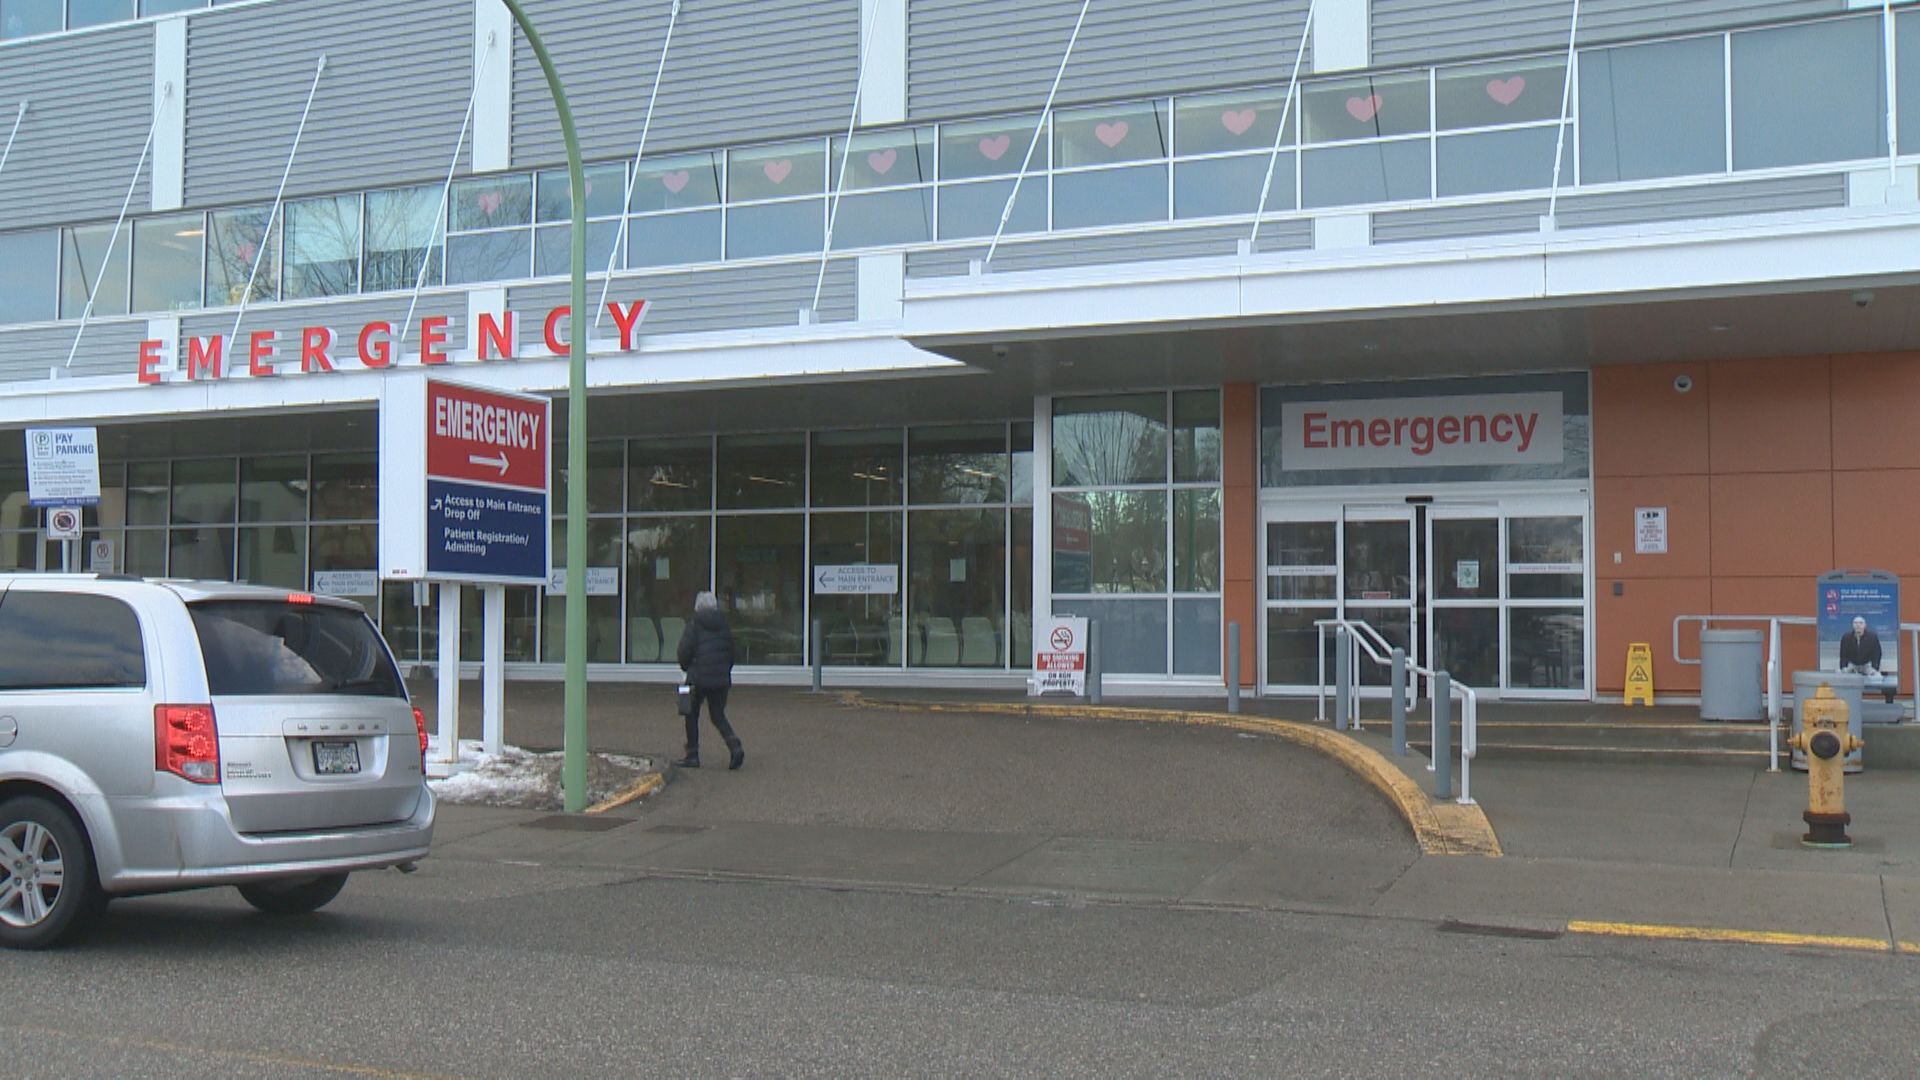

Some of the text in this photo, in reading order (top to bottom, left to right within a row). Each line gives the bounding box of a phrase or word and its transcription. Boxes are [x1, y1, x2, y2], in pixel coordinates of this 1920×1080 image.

[138, 300, 649, 384] EMERGENCY
[436, 396, 540, 451] EMERGENCY
[55, 433, 73, 444] PAY
[1303, 412, 1539, 456] Emergency
[56, 443, 95, 455] PARKING
[445, 493, 541, 514] Access to Main Entrance
[445, 507, 481, 521] Drop Off
[445, 527, 529, 546] Patient Registration/
[445, 541, 487, 556] Admitting
[838, 575, 894, 583] MAIN ENTRANCE
[1053, 653, 1080, 662] SMOKING
[1047, 661, 1075, 670] ALLOWED
[1043, 679, 1075, 687] PROPERTY
